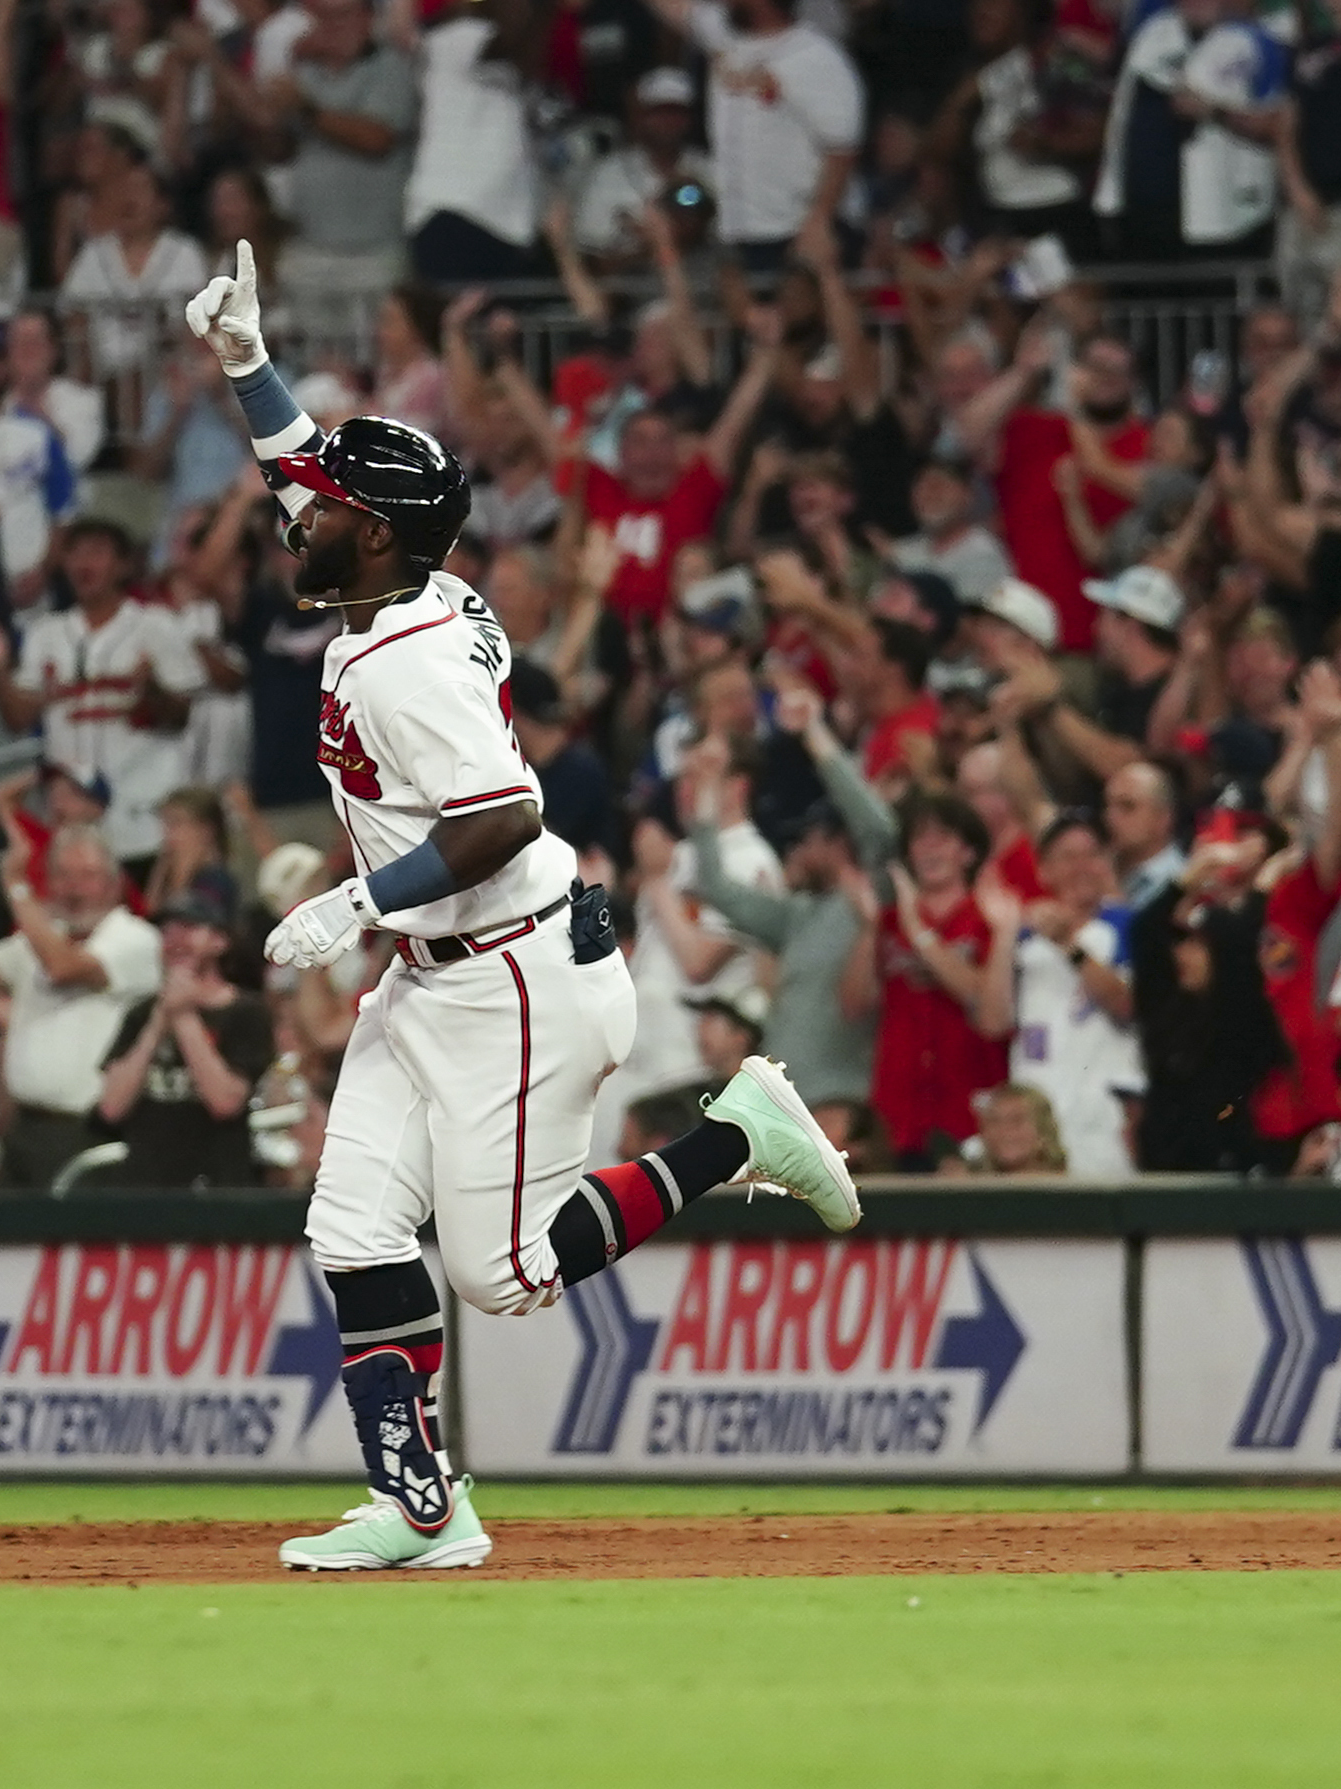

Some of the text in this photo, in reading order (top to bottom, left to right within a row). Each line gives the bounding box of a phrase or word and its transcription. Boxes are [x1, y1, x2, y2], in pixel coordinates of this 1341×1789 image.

[5, 1243, 293, 1377] ARROW
[657, 1240, 956, 1373] ARROW
[647, 1388, 951, 1455] EXTERMINATORS
